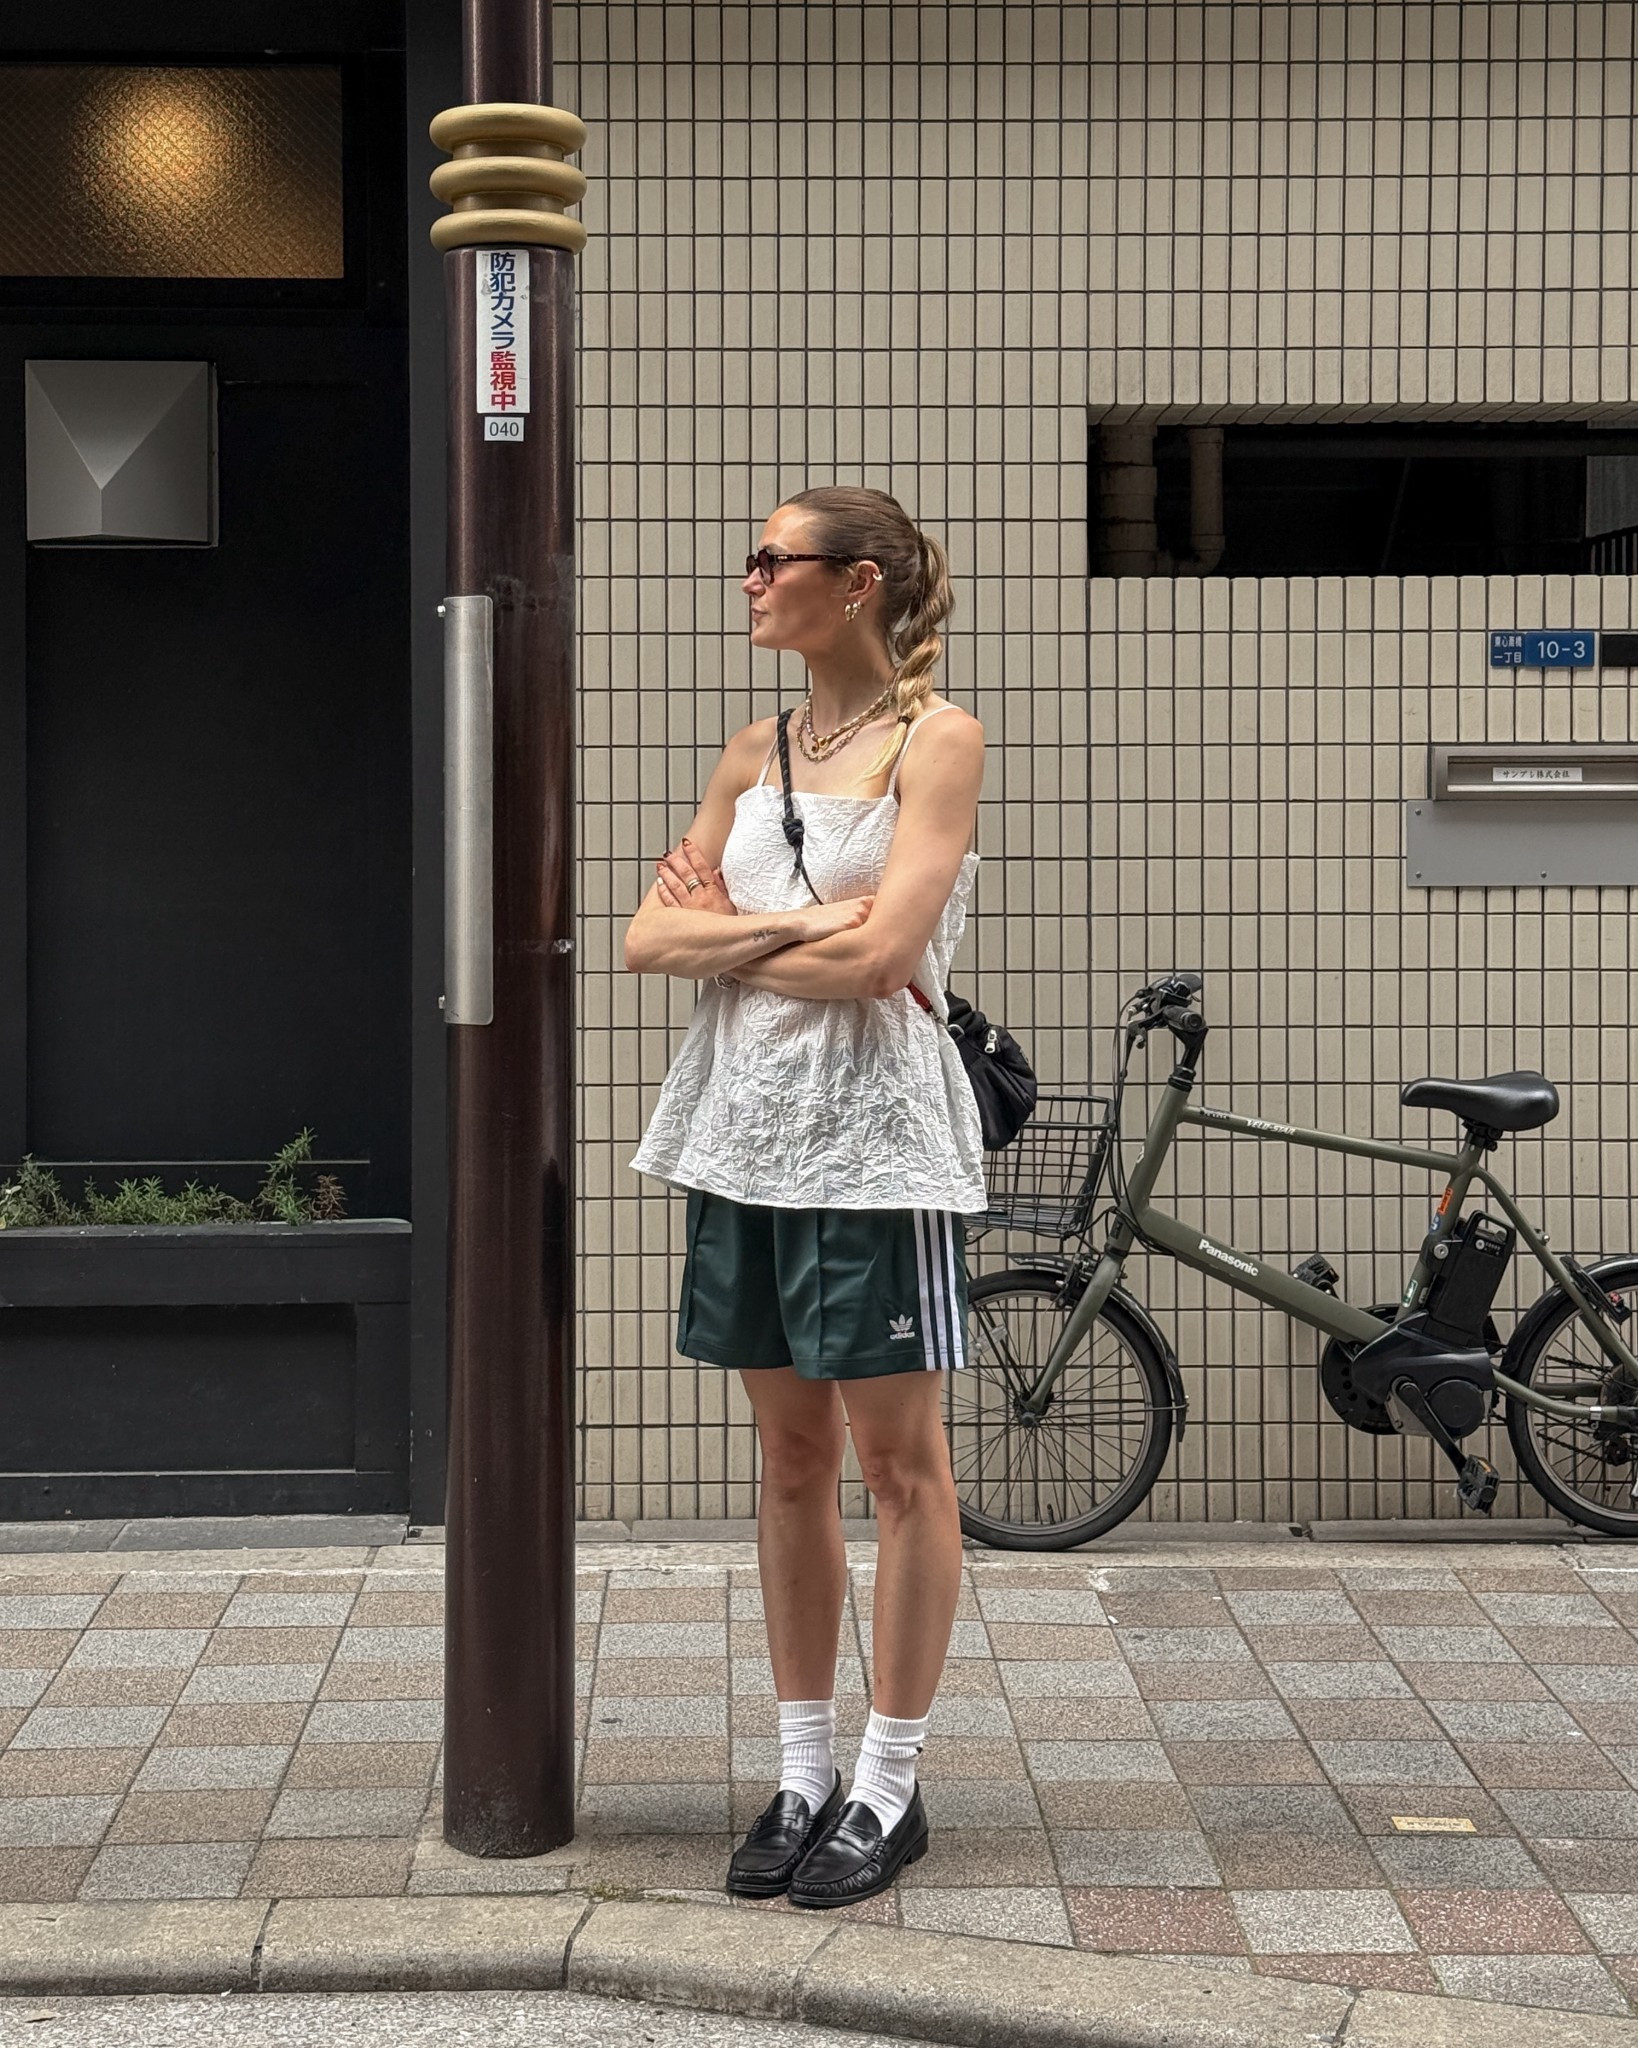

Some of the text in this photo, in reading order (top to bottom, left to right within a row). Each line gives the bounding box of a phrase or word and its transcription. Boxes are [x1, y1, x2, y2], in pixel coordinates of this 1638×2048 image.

[490, 252, 517, 411] 防犯カメラ監視中
[489, 421, 520, 437] 040
[1493, 651, 1522, 664] 一丁目
[1537, 640, 1586, 659] 10-3
[1198, 1238, 1259, 1277] Panasonic
